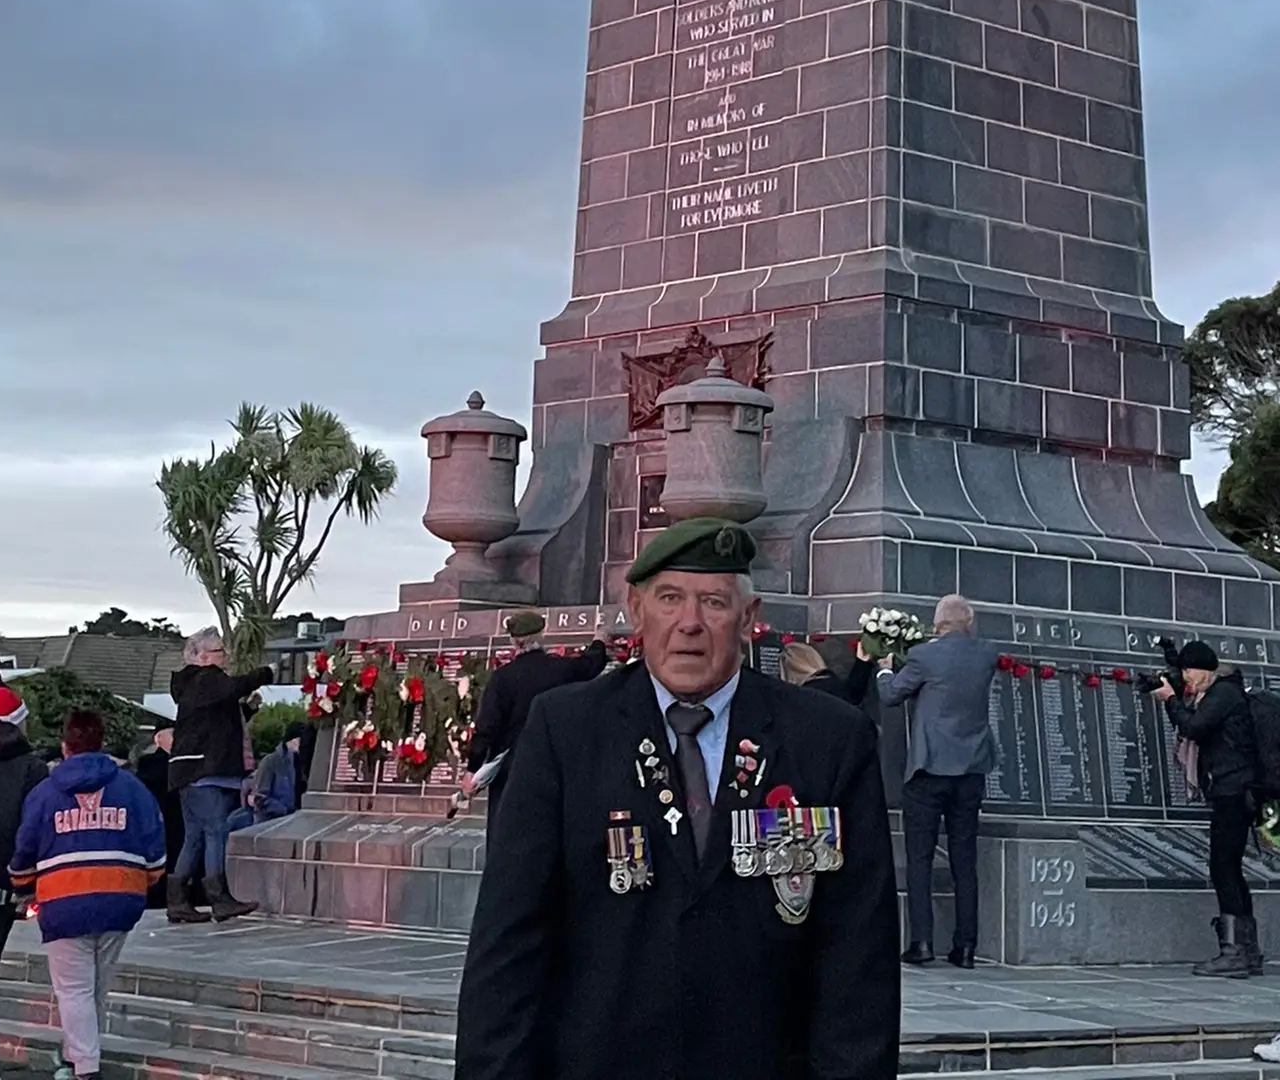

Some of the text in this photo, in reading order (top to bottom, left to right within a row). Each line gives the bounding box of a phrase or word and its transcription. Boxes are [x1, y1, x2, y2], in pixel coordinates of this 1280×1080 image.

[690, 26, 715, 41] WHO
[761, 7, 774, 23] IN
[687, 53, 705, 69] THE
[687, 118, 699, 132] IN
[752, 102, 767, 118] OF
[717, 141, 743, 157] WHO
[672, 192, 700, 211] THEIR
[737, 177, 778, 198] LIVETH
[681, 213, 701, 229] FOR
[411, 615, 467, 633] DIED
[1015, 621, 1081, 641] DIED
[1030, 857, 1076, 883] 1939
[1030, 900, 1076, 928] 1945
